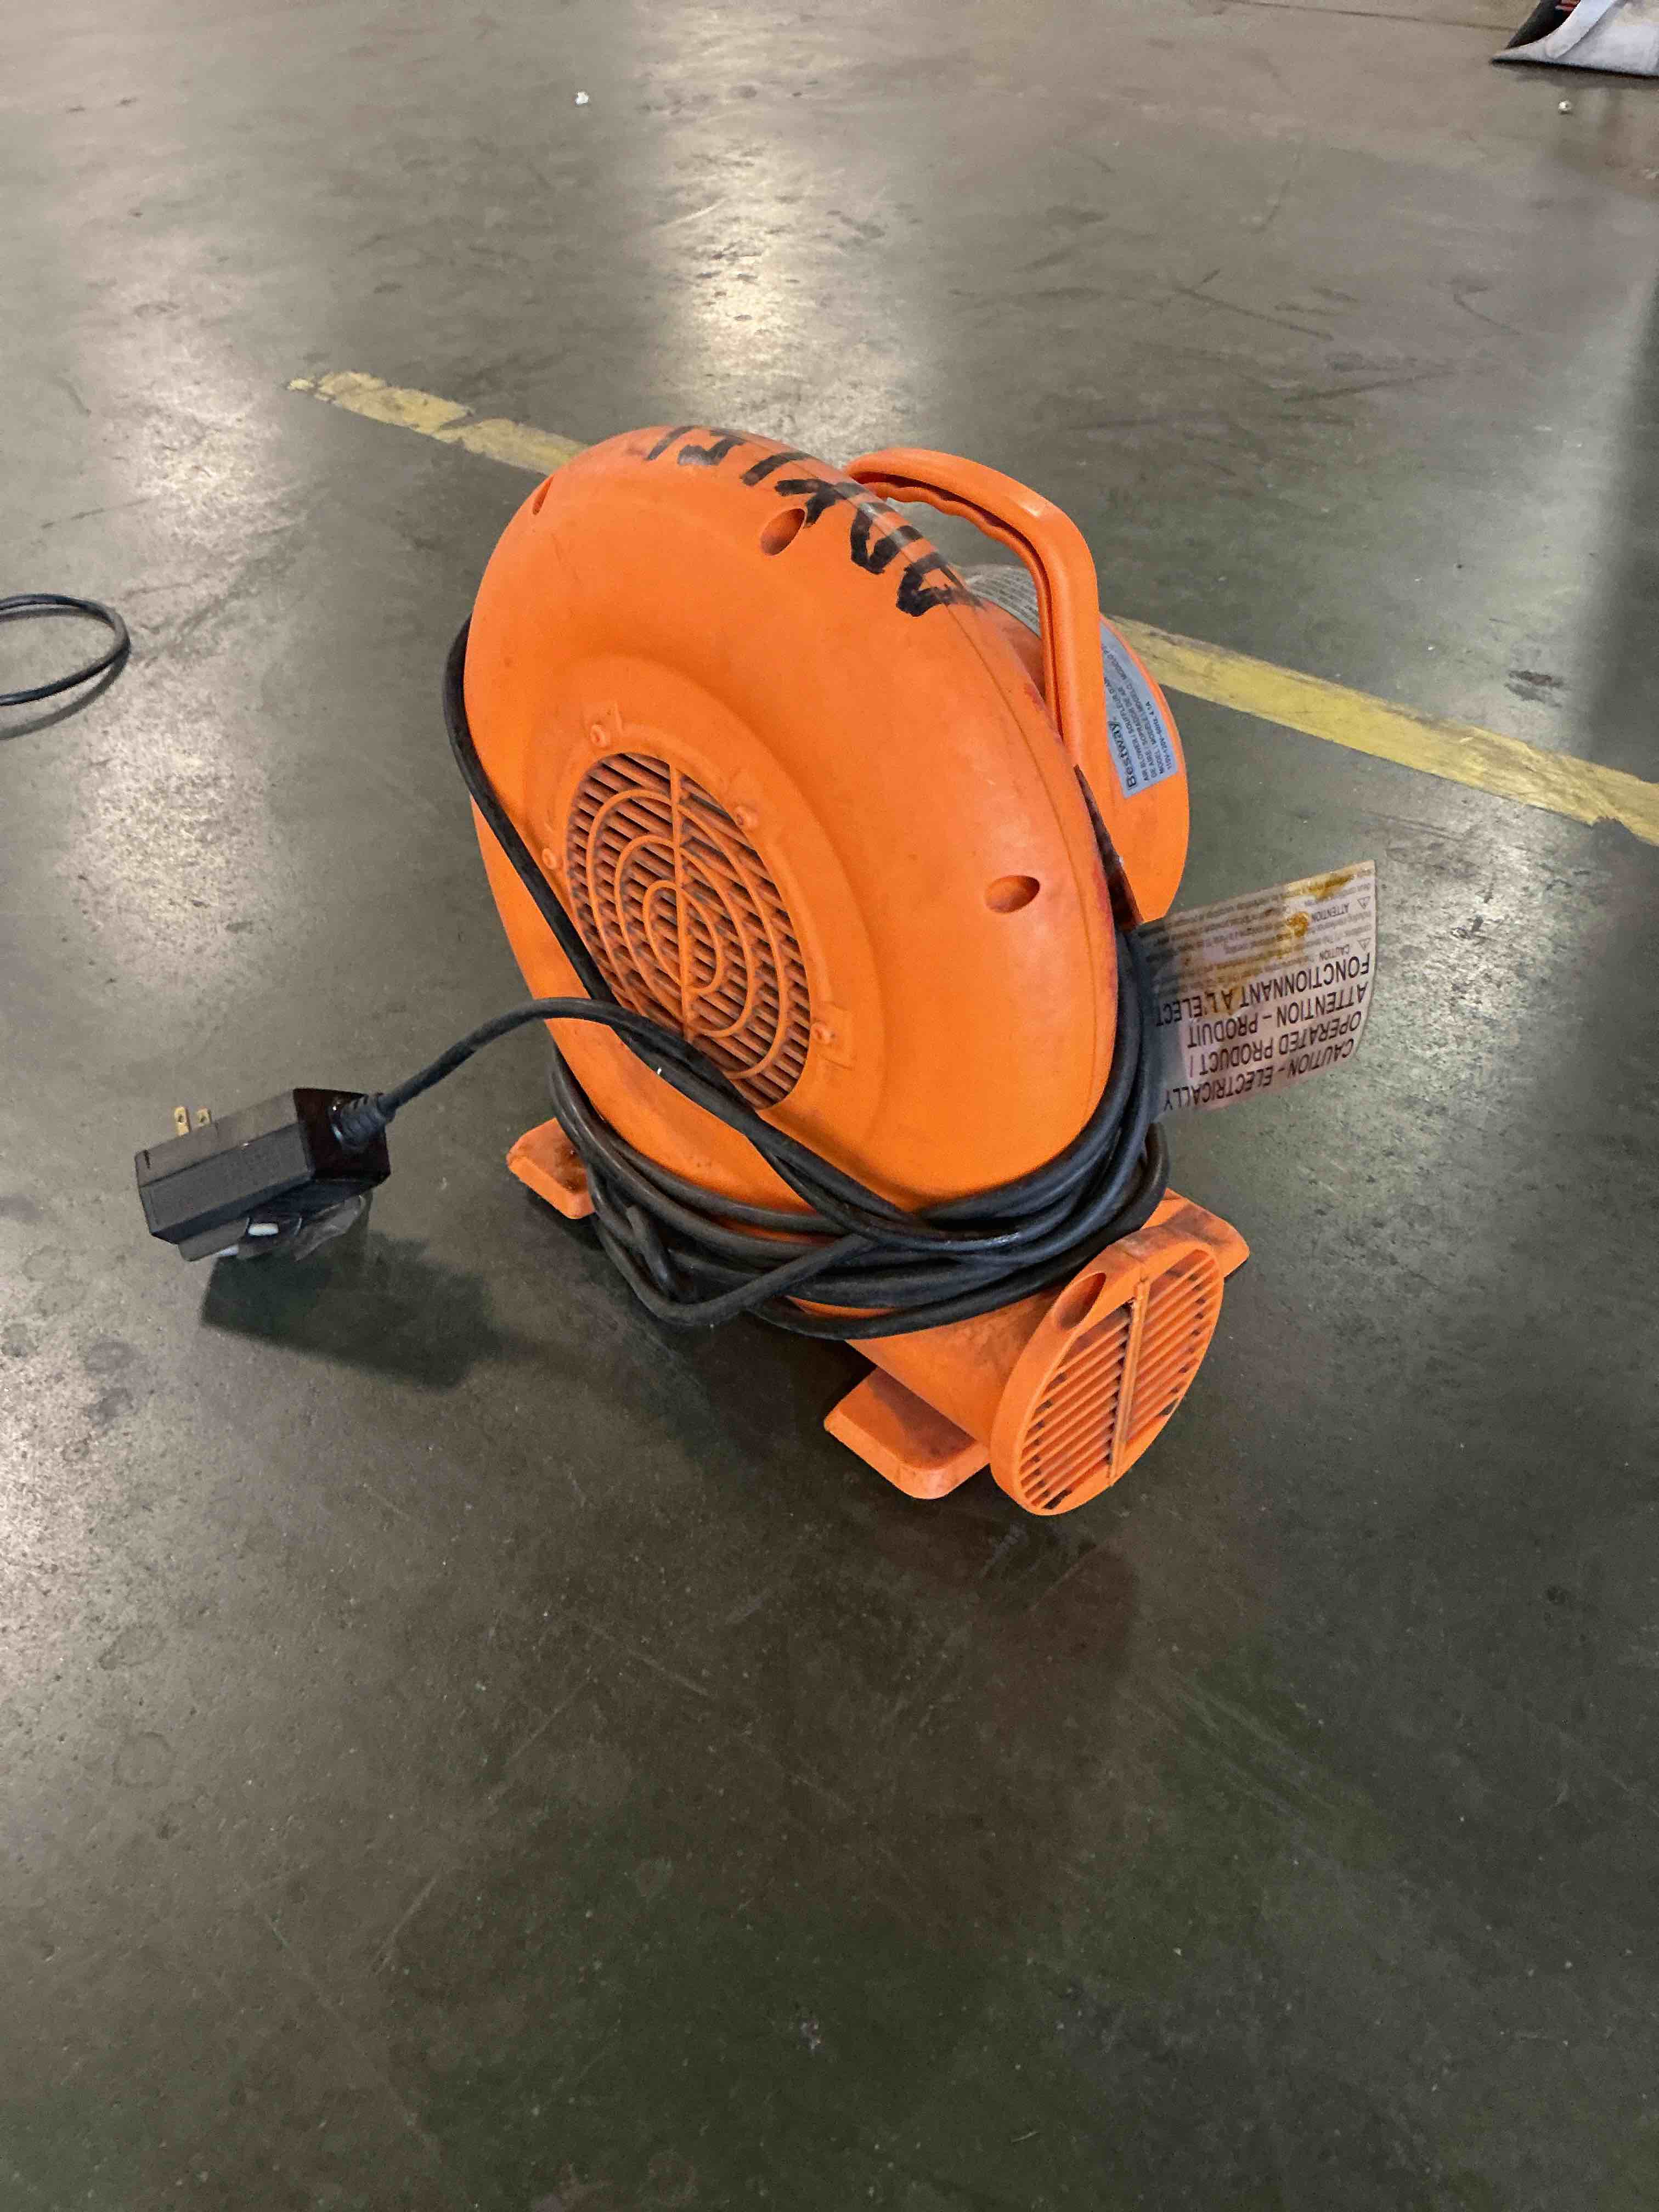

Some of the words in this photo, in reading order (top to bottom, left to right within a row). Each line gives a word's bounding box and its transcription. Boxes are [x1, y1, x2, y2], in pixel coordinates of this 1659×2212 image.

[1107, 720, 1138, 788] Bestway
[1312, 903, 1348, 922] ATTENTION
[1319, 944, 1349, 960] CAUTION
[1240, 952, 1369, 1008] FONCTIONNANT
[1277, 981, 1368, 1028] ATTENTION
[1187, 1012, 1257, 1048] PRODUIT
[1280, 1010, 1361, 1055] OPERATED
[1199, 1037, 1273, 1076] PRODUCT
[1287, 1038, 1355, 1080] CAUTION
[1164, 1065, 1273, 1112] ELECTRICALLY
